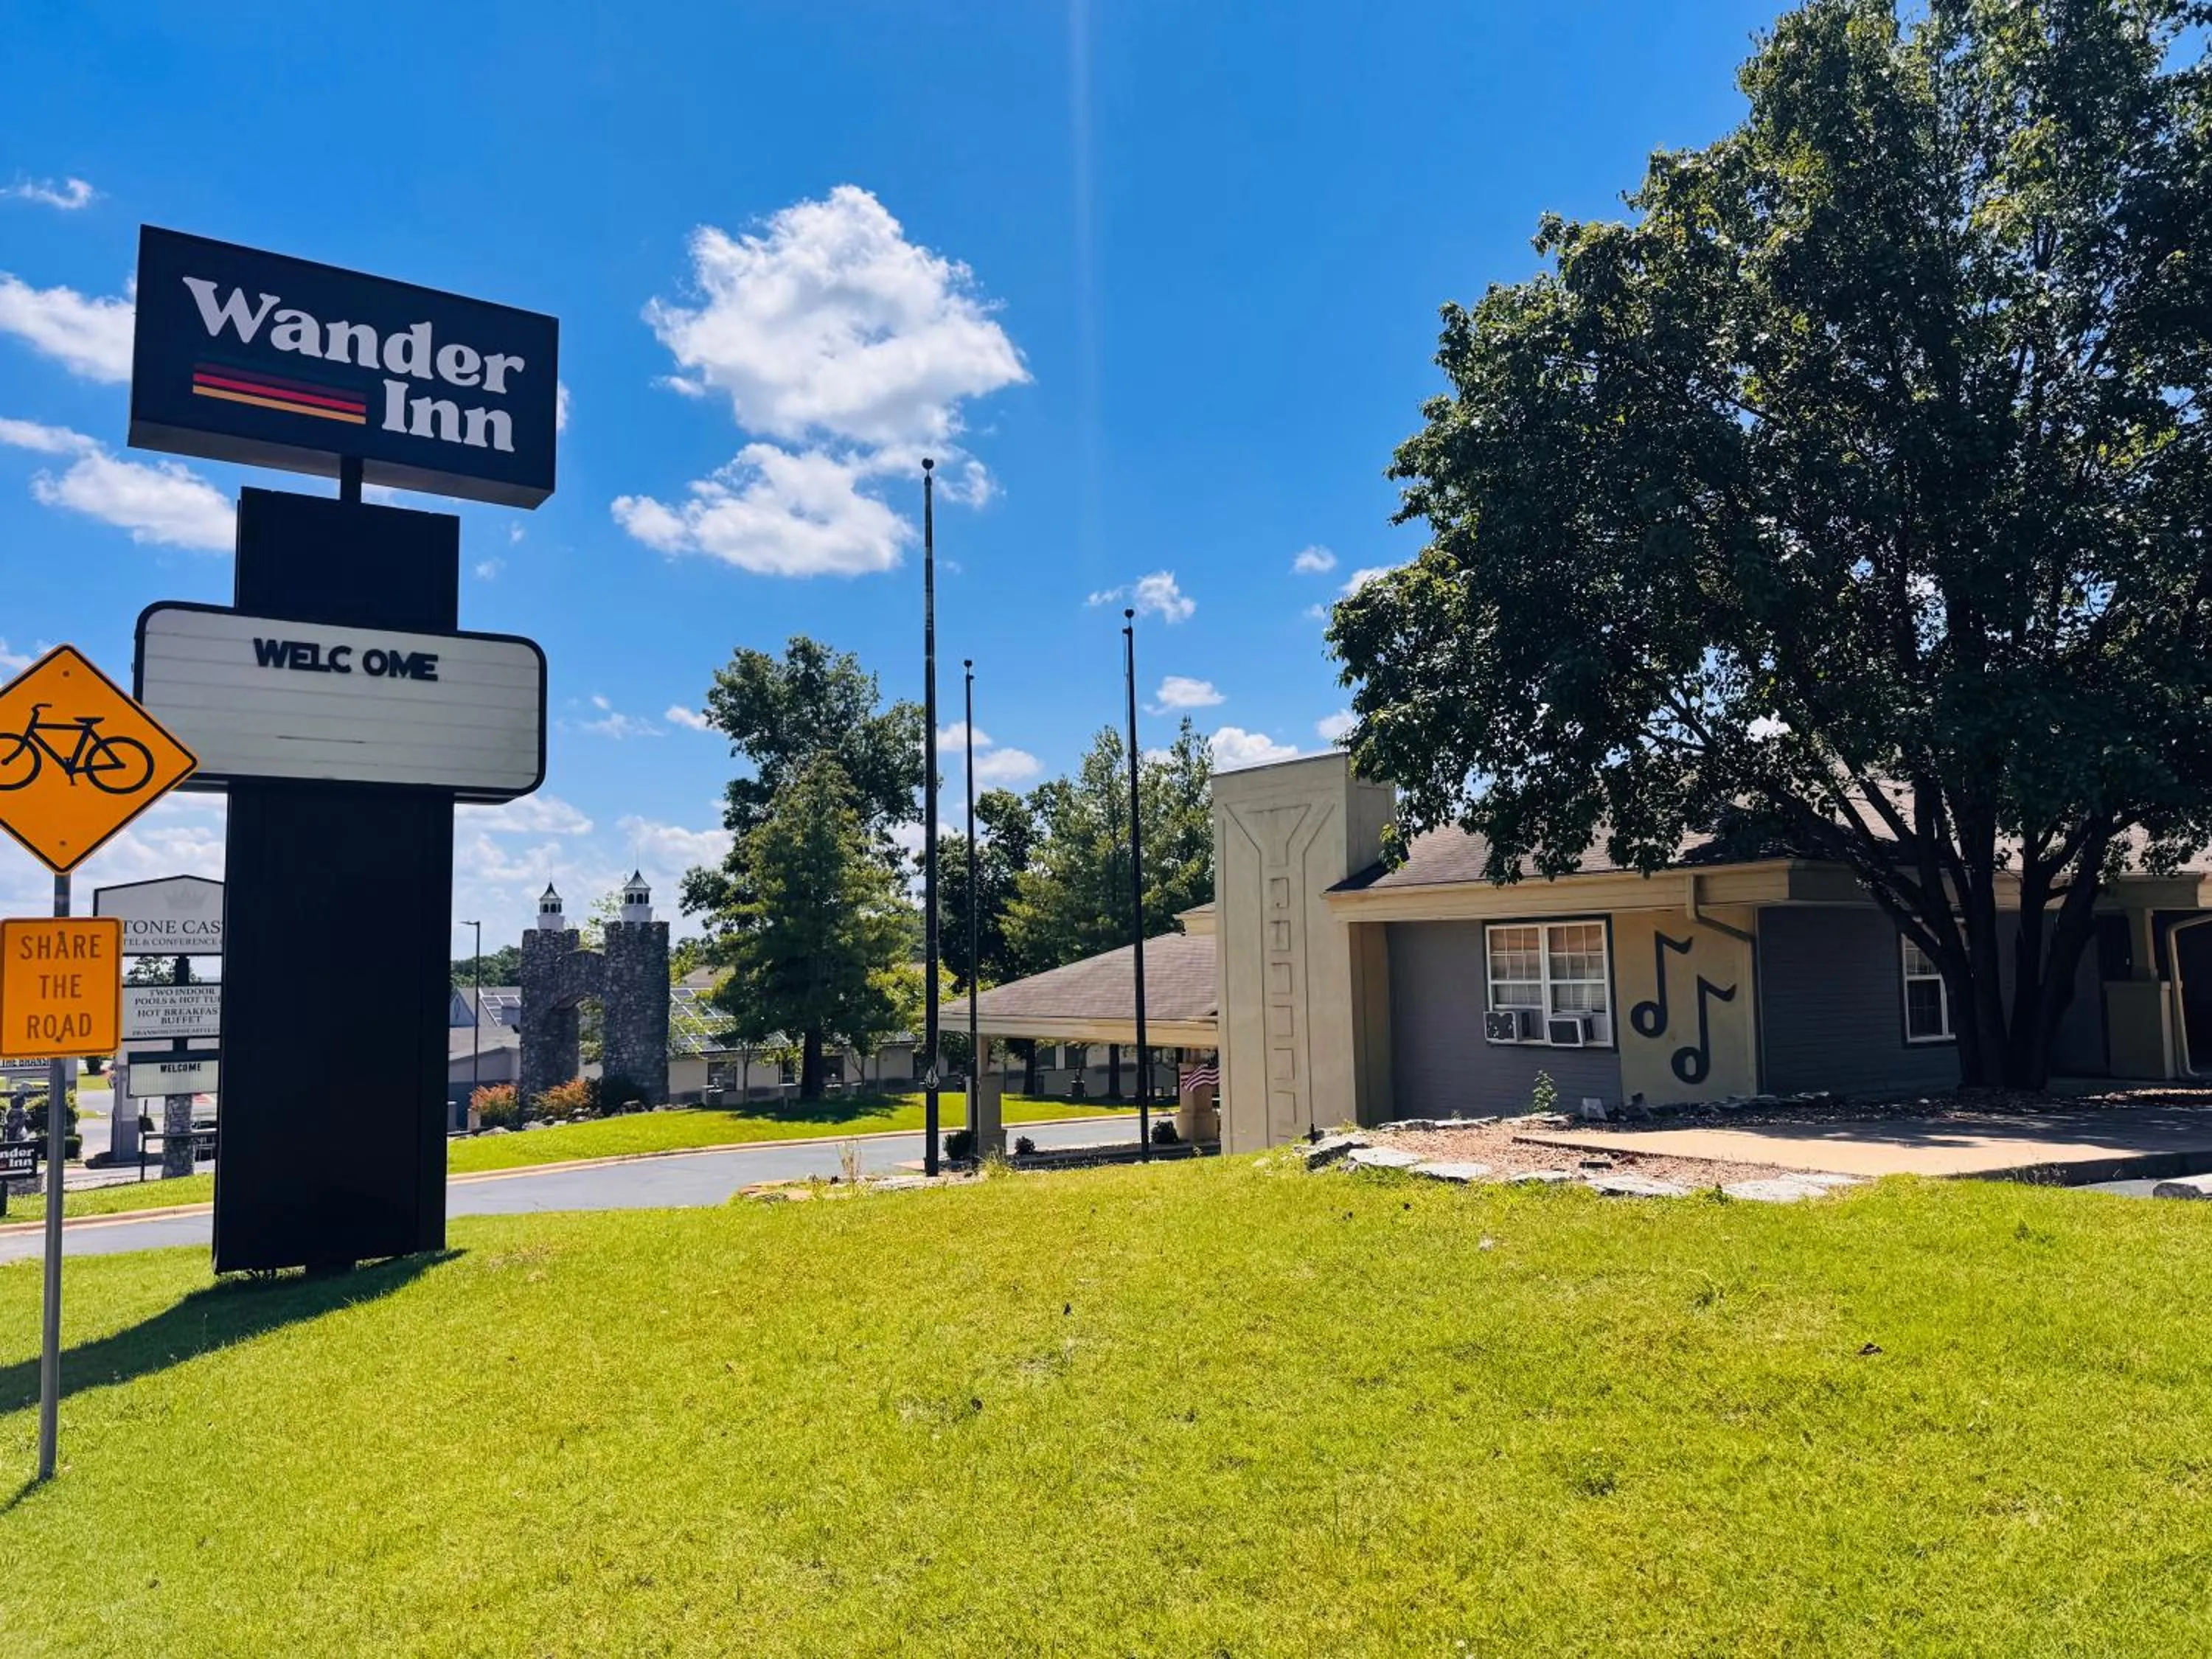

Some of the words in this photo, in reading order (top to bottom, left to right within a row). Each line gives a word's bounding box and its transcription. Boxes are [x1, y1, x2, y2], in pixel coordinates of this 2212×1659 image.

[182, 276, 525, 394] Wander
[380, 378, 515, 452] Inn
[123, 919, 177, 934] TONE
[182, 919, 221, 934] CAS
[20, 933, 102, 959] SHARE
[150, 936, 216, 945] CONFERENCE
[38, 974, 83, 1000] THE
[175, 987, 215, 996] INDOOR
[135, 996, 167, 1005] POOLS
[178, 995, 201, 1004] HOT
[203, 995, 220, 1004] TU
[138, 1009, 160, 1018] HOT
[164, 1007, 218, 1016] BREAKFAS
[161, 1015, 201, 1025] BUFFET
[27, 1012, 92, 1040] ROAD
[160, 1062, 201, 1074] WELCOME
[0, 1147, 35, 1158] nder
[9, 1158, 33, 1168] Inn
